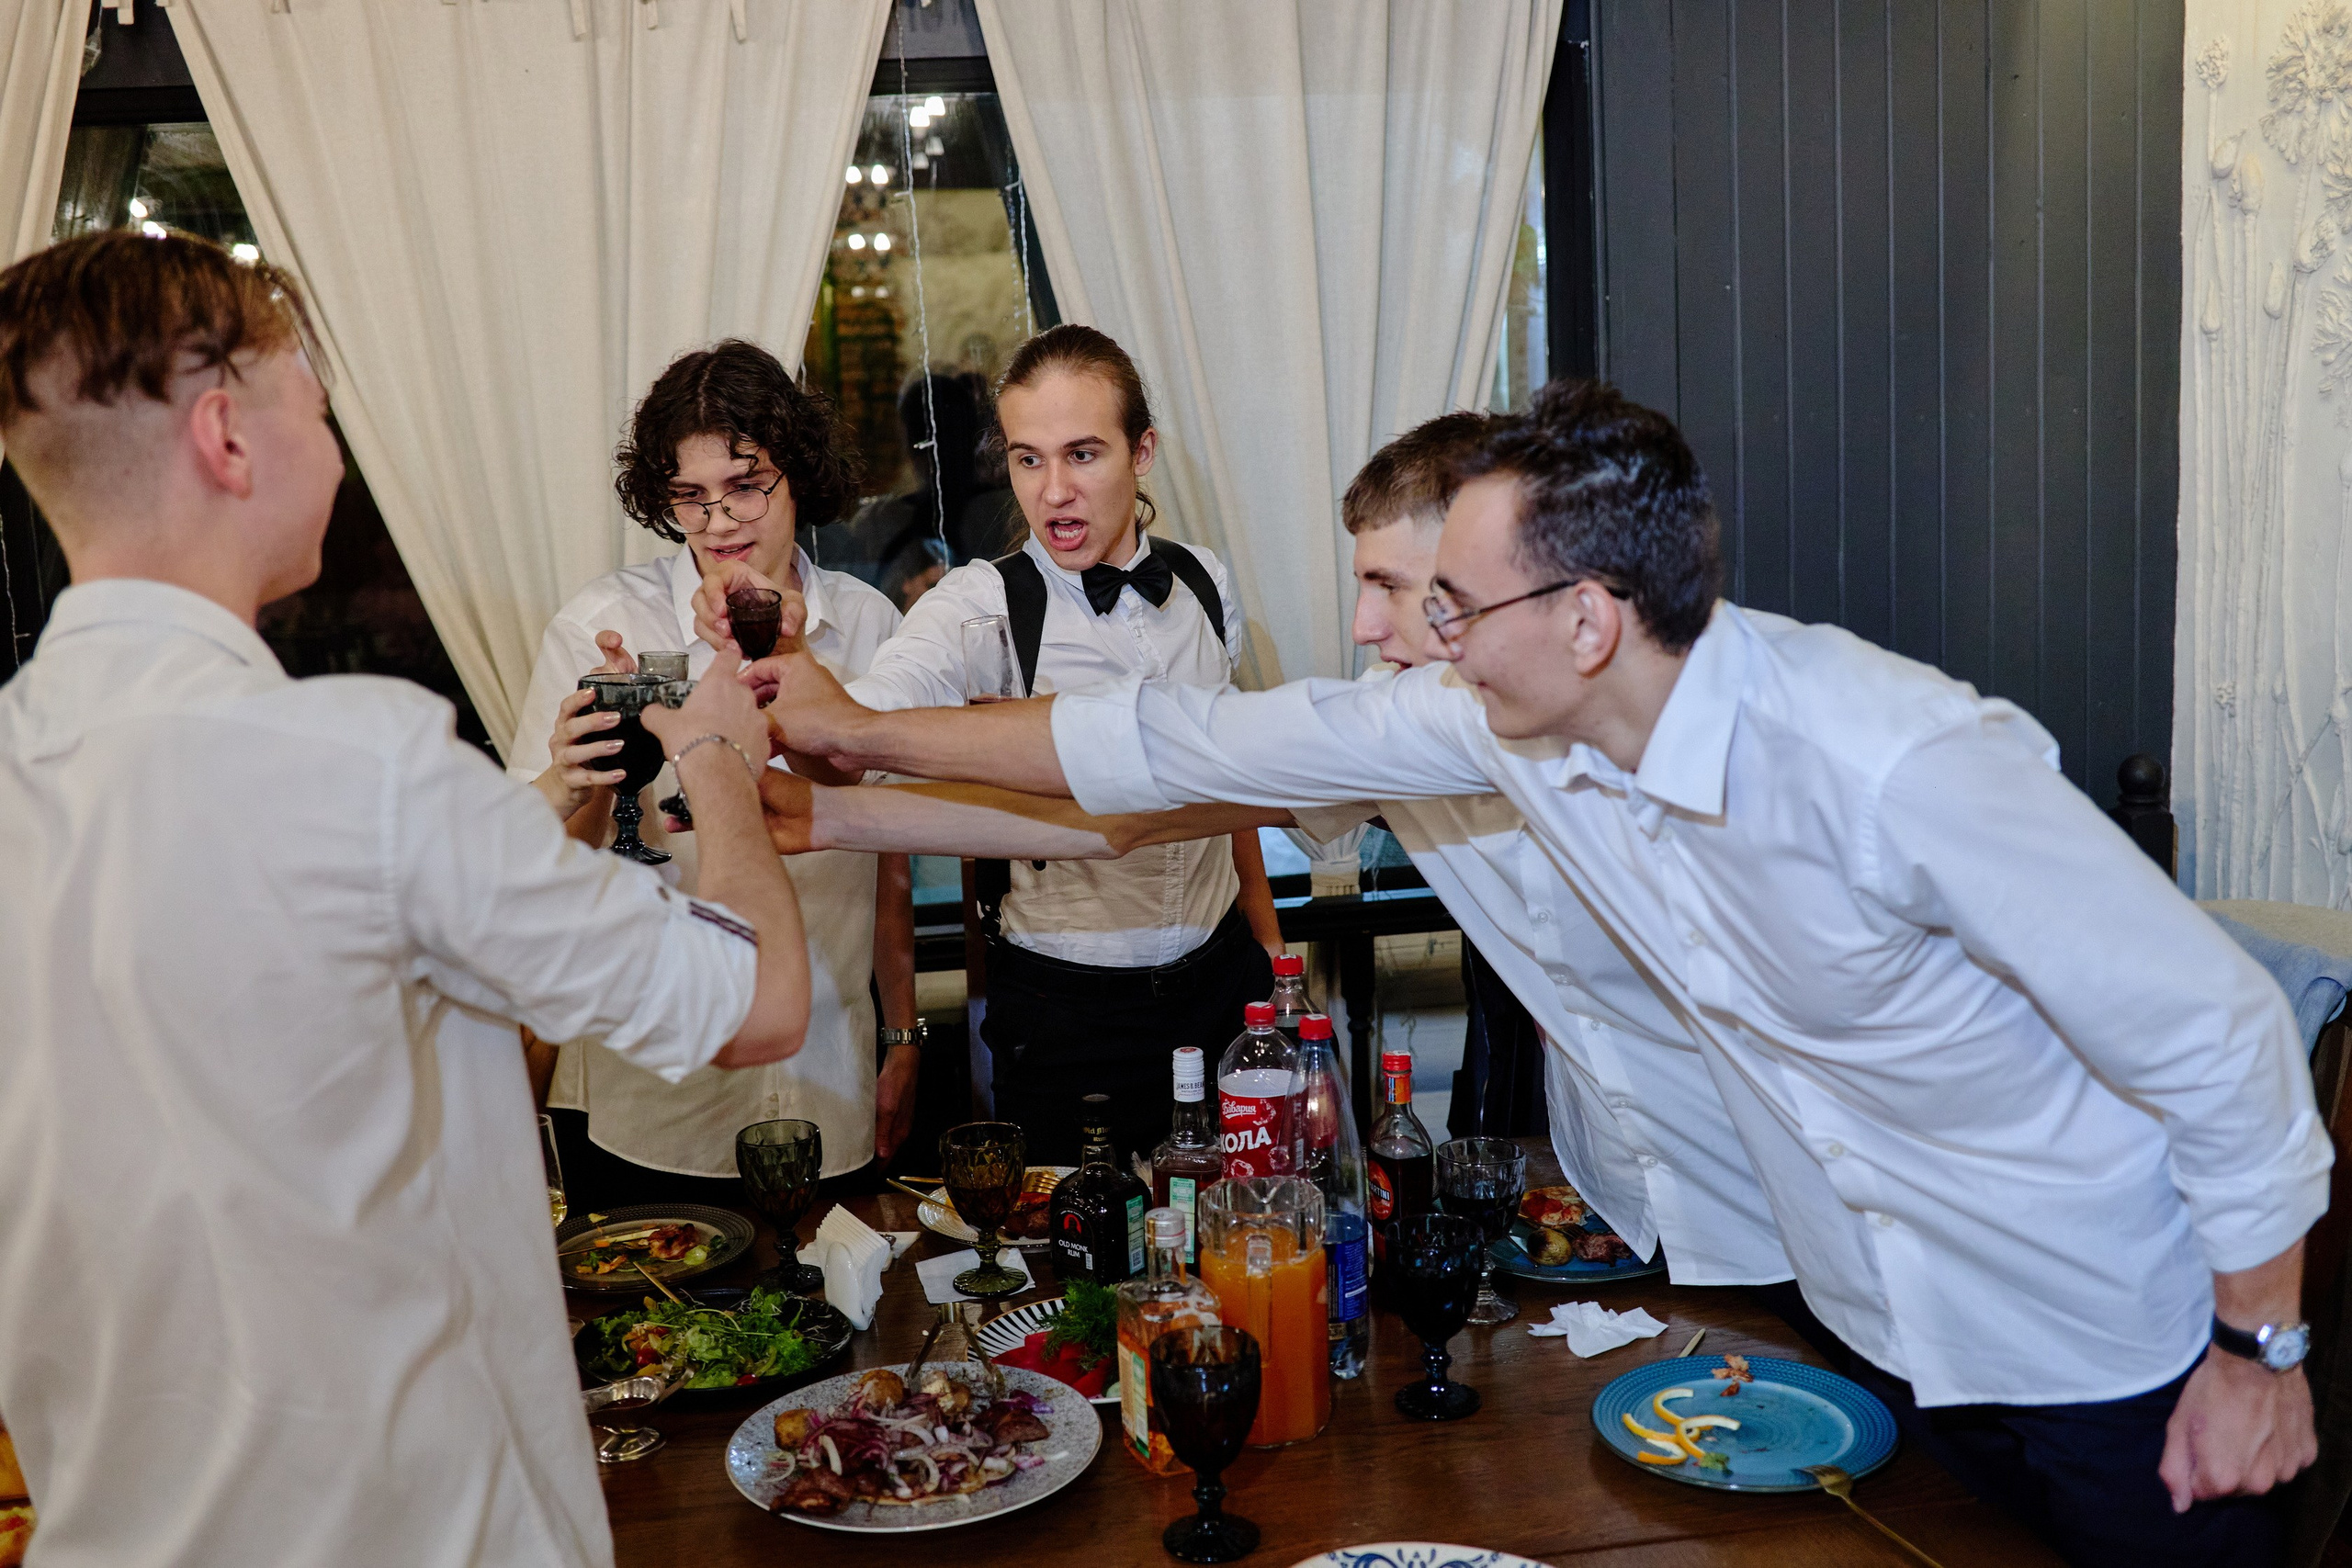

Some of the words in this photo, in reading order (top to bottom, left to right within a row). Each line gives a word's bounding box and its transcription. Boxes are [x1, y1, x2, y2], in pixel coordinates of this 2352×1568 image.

[1222, 1099, 1257, 1118] Бавария
[1058, 1239, 1070, 1248] OLD
[1070, 1242, 1089, 1253] MONK
[1067, 1248, 1080, 1258] RUM
